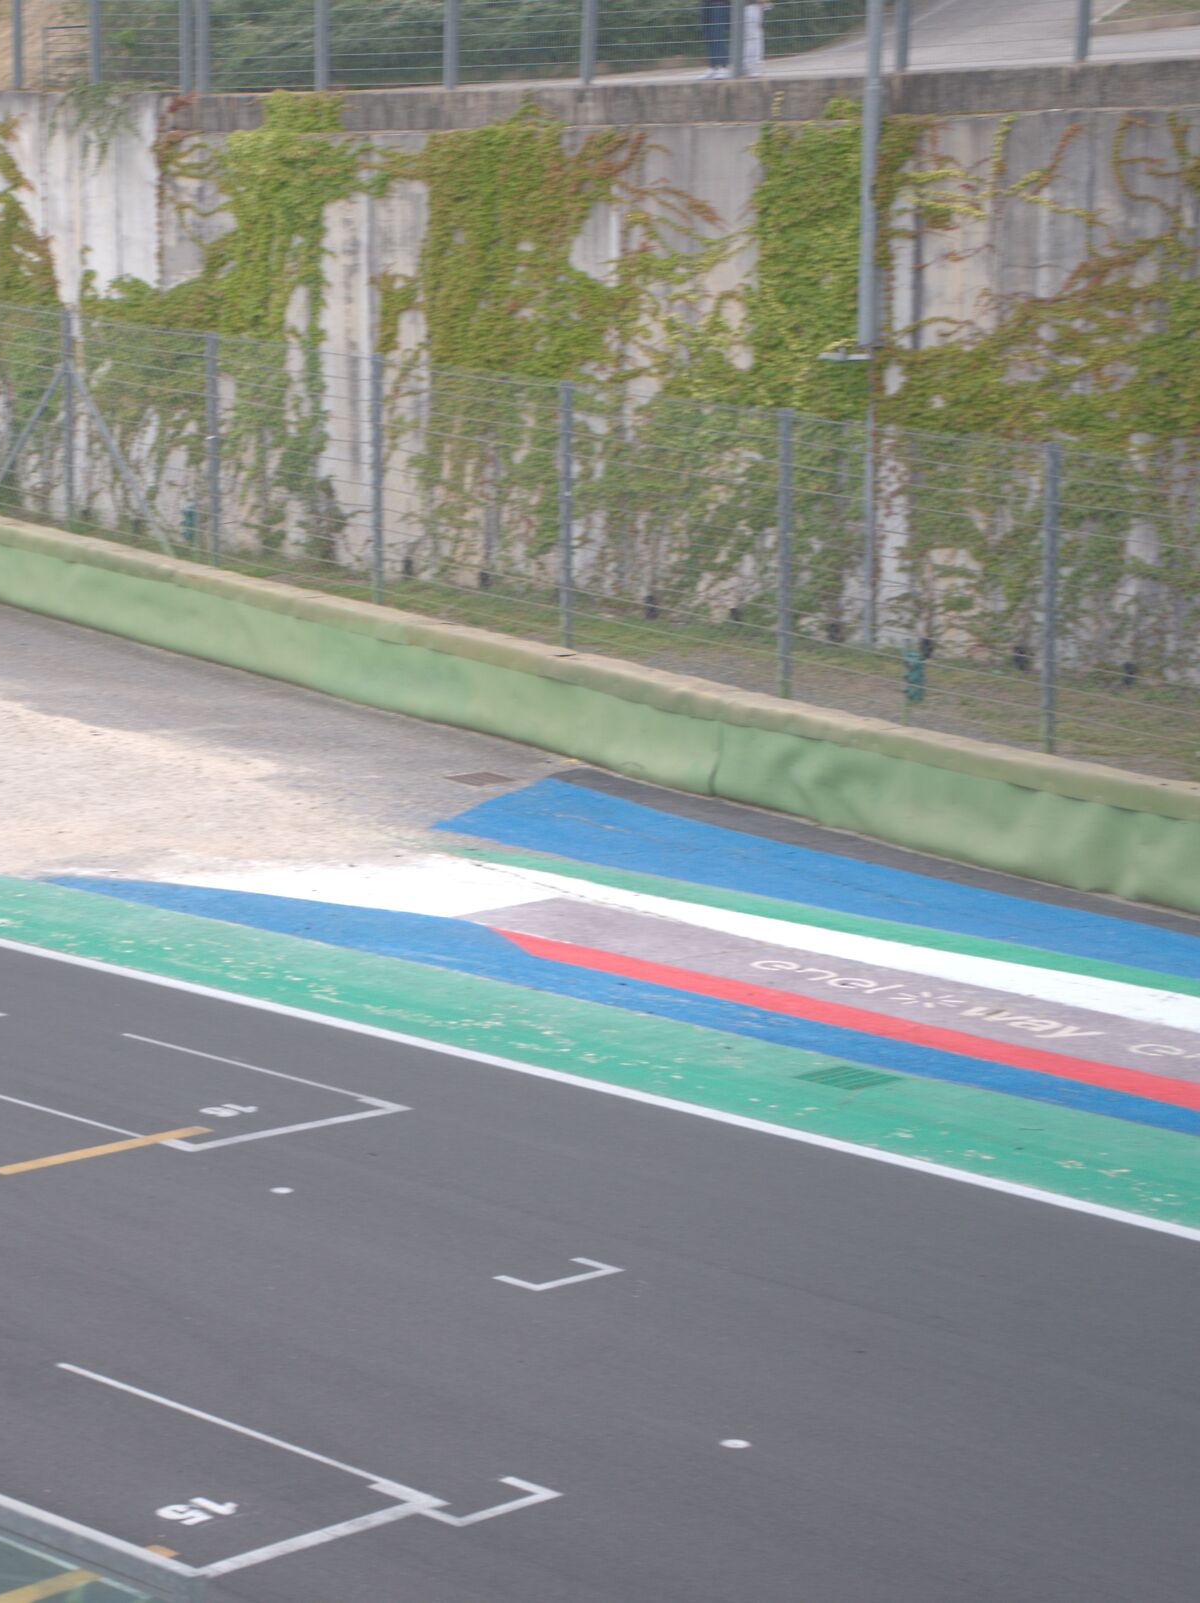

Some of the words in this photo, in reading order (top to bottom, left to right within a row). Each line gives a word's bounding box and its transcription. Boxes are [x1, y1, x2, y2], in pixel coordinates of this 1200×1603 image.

[750, 959, 904, 994] enel
[958, 1006, 1106, 1038] way
[155, 1496, 239, 1526] 15
